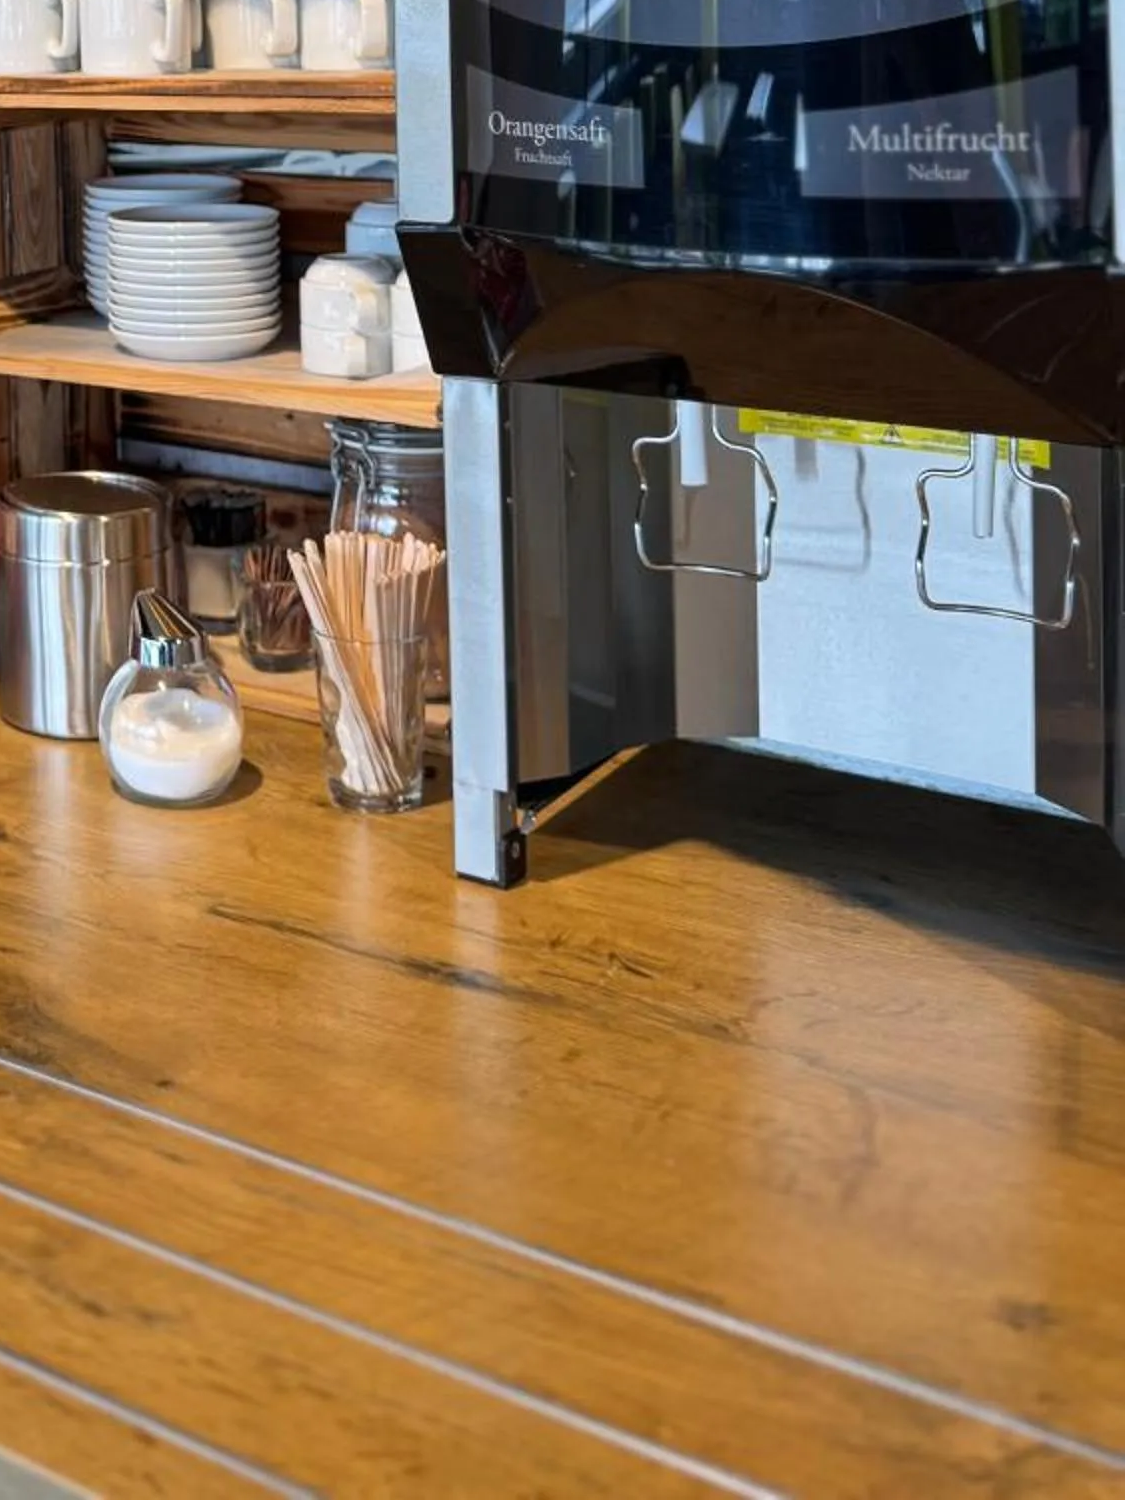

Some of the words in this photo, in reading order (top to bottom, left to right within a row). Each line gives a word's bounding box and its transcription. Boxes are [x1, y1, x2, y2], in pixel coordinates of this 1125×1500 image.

[488, 110, 607, 147] Orangensaft
[848, 121, 1031, 153] Multifrucht
[907, 163, 971, 182] Nektar
